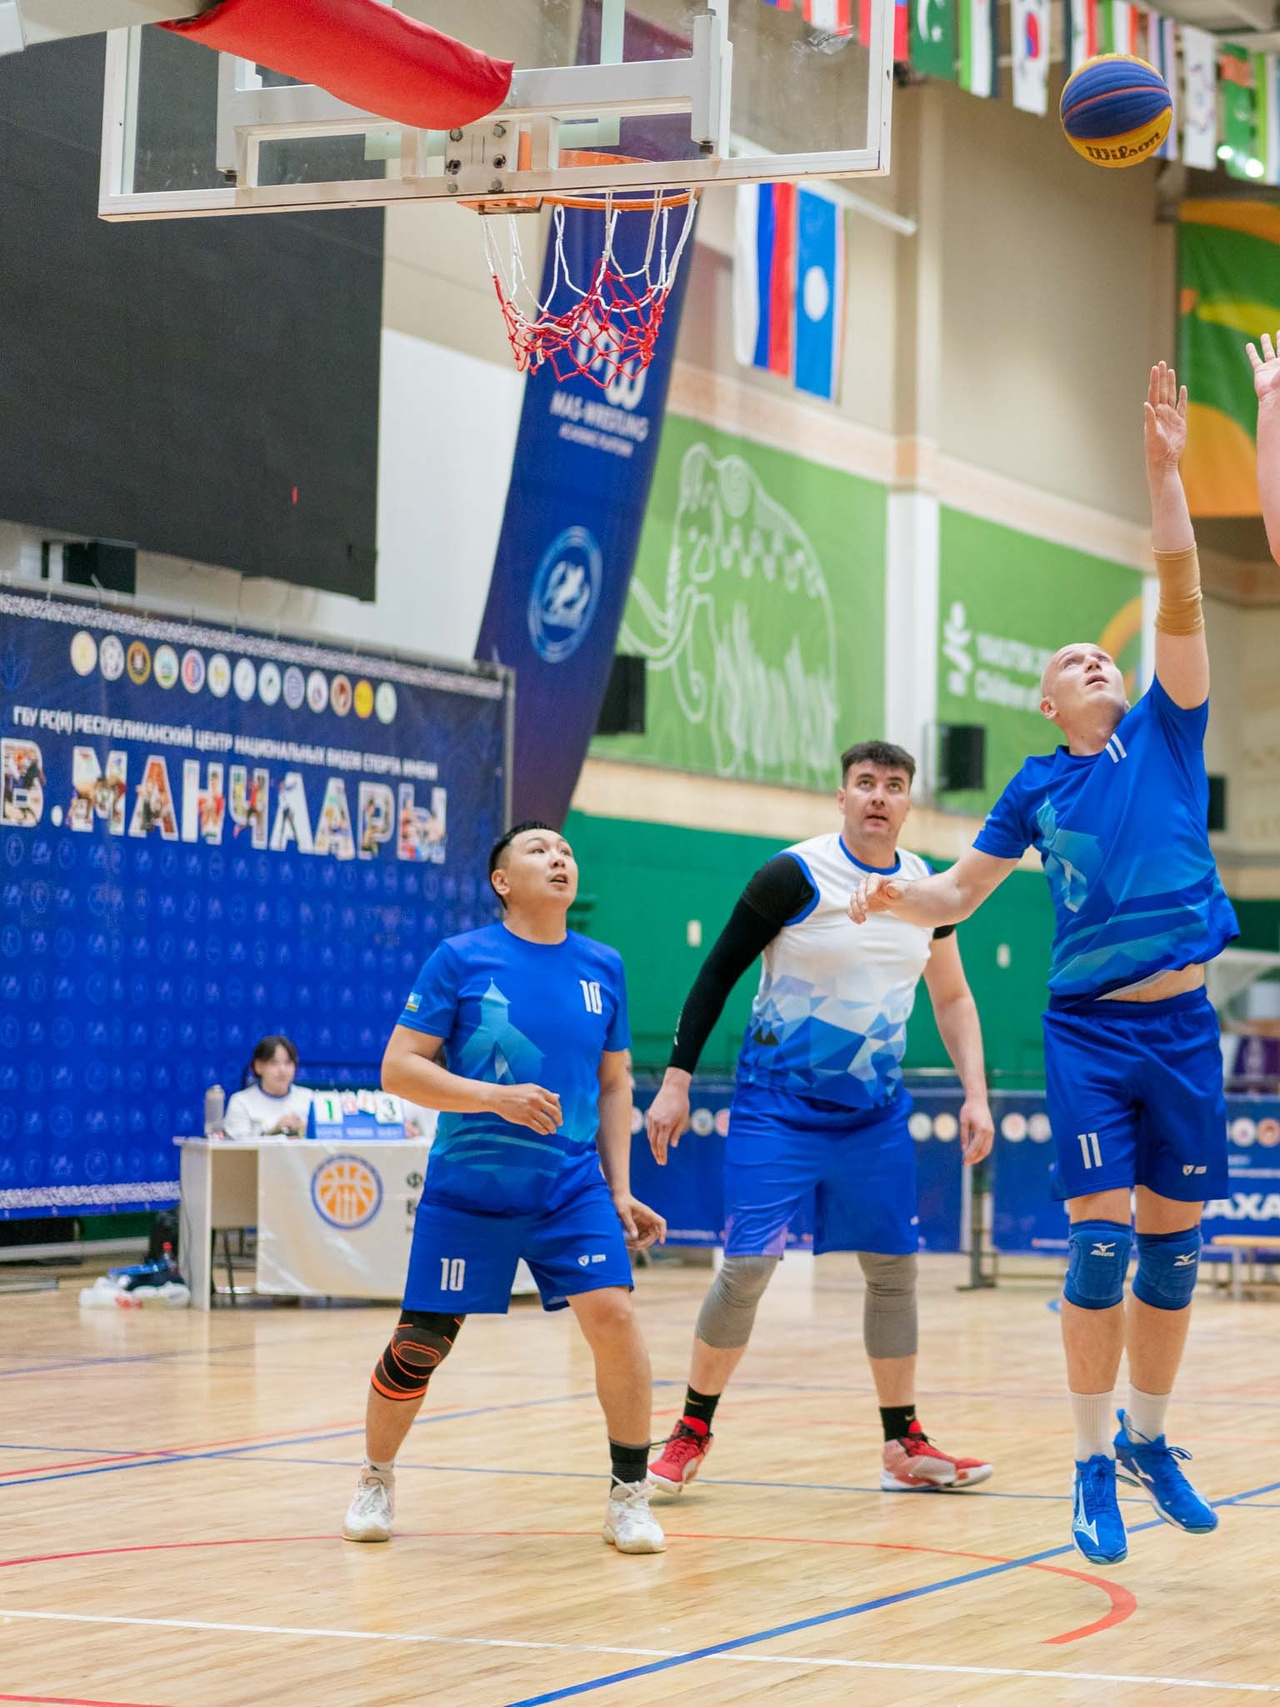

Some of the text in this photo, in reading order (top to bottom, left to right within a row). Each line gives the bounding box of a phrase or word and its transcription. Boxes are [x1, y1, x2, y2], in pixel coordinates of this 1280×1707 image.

[1086, 132, 1160, 160] Wilson
[74, 713, 194, 748] РЕСПУБЛИКАНСКИЙ
[196, 728, 233, 752] ЦЕНТР
[579, 979, 602, 1015] 10
[1077, 1132, 1103, 1170] 11
[440, 1257, 466, 1292] 10
